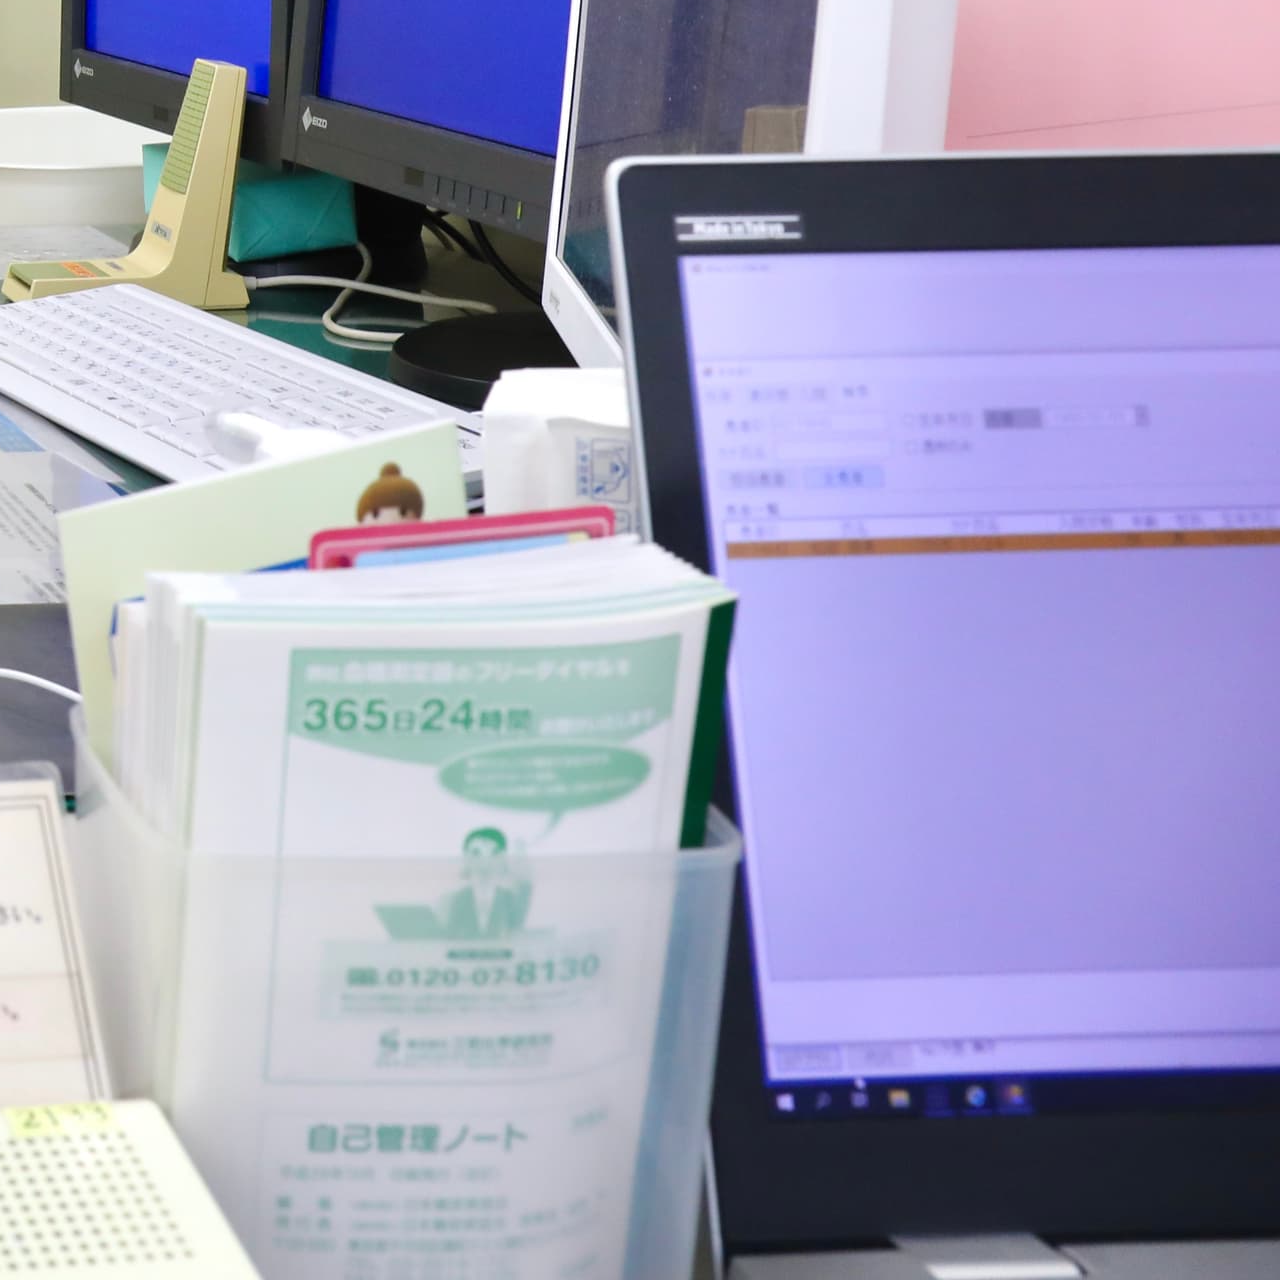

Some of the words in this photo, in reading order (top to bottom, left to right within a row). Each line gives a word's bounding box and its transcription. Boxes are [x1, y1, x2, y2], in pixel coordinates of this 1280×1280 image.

[312, 115, 328, 129] EIZO
[307, 1121, 529, 1154] 自己管理ノート
